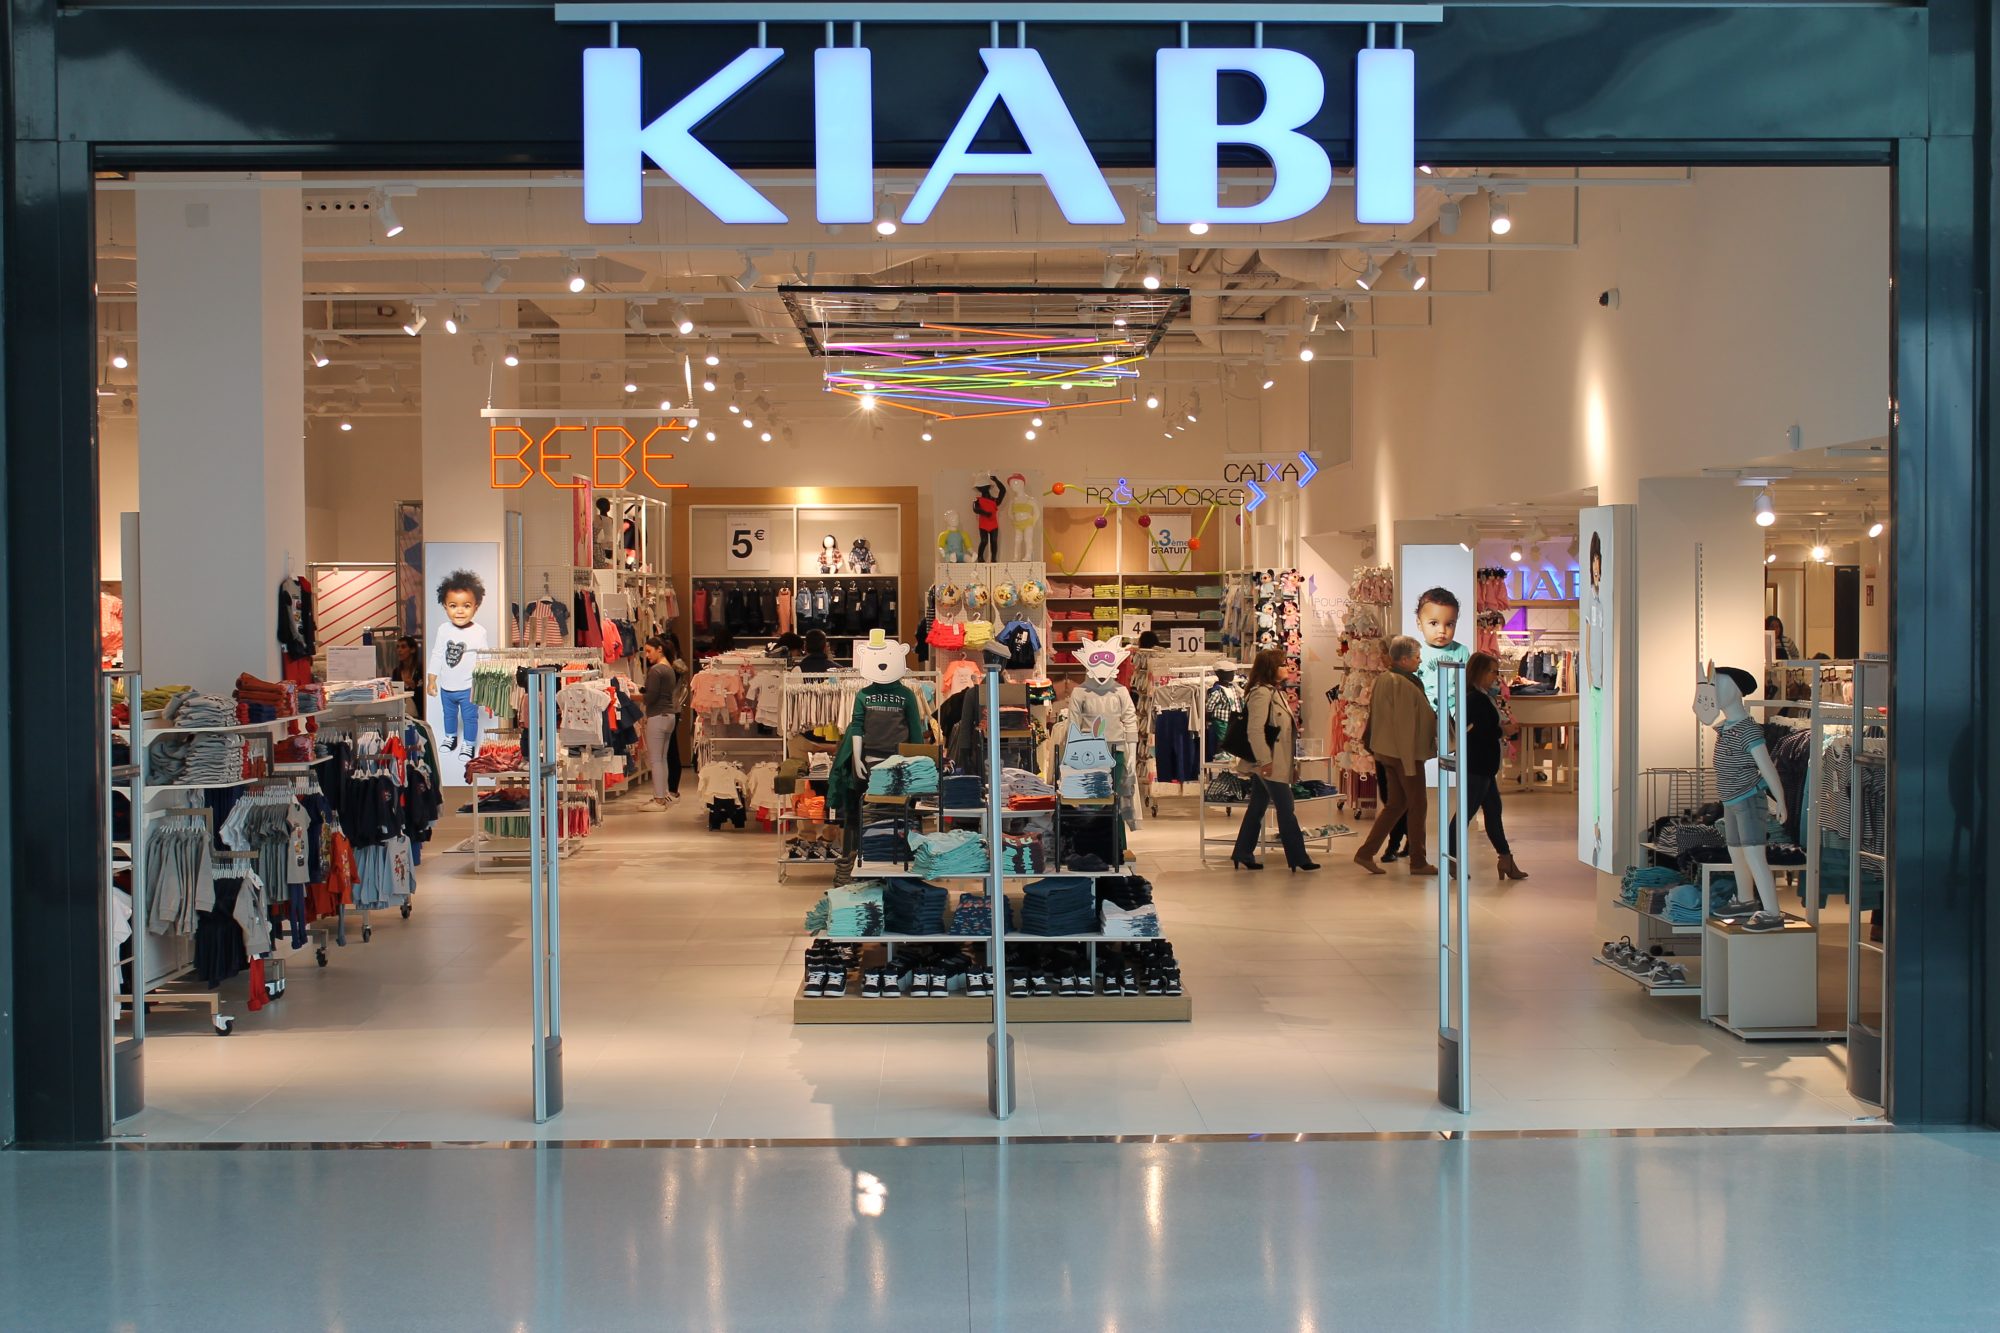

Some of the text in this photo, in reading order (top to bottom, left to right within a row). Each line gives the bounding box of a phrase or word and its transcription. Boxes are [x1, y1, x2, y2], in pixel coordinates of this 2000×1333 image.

[583, 47, 1414, 225] KIABI
[490, 417, 690, 489] BEBÉ
[1224, 462, 1299, 483] CAIXA
[865, 693, 906, 706] PERFECT
